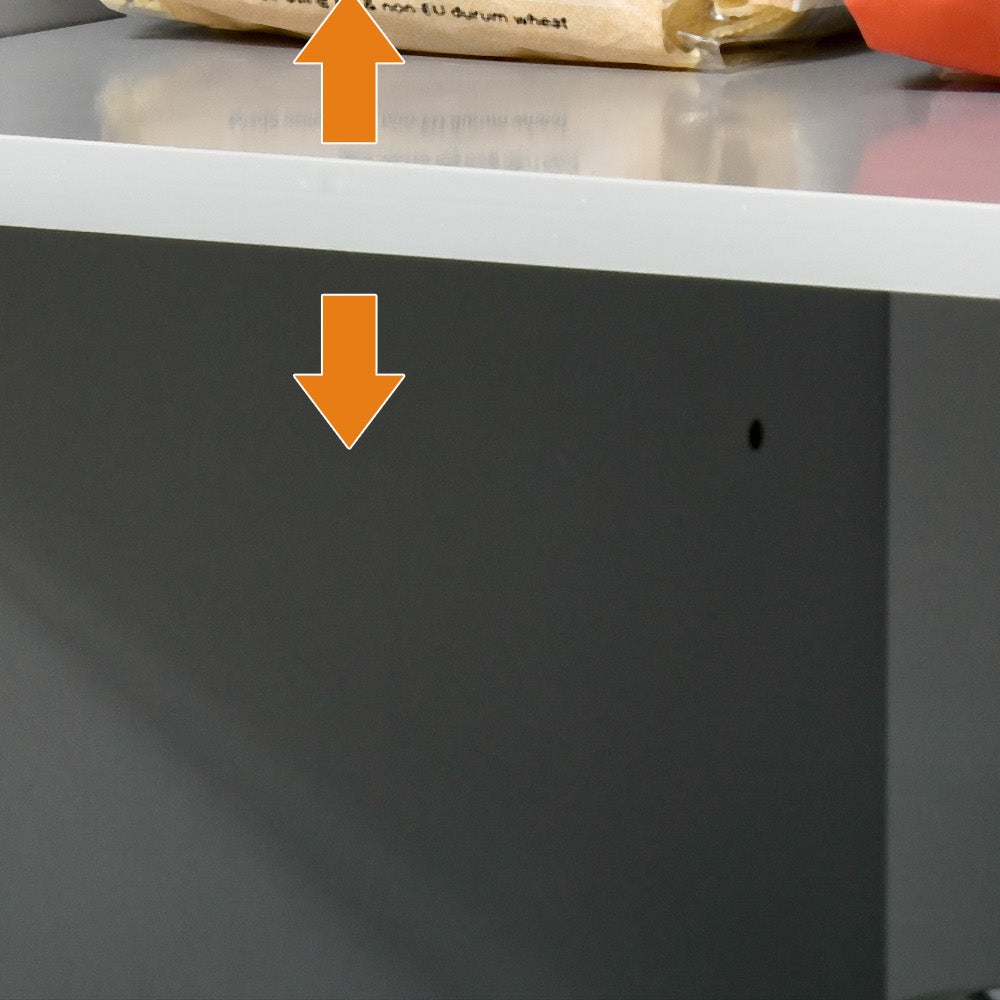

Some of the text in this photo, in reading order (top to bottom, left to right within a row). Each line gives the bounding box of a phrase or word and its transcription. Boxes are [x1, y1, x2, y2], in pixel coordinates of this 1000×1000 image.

[382, 2, 416, 13] non
[421, 2, 446, 16] EU
[450, 5, 508, 23] durum
[513, 13, 568, 30] wheat
